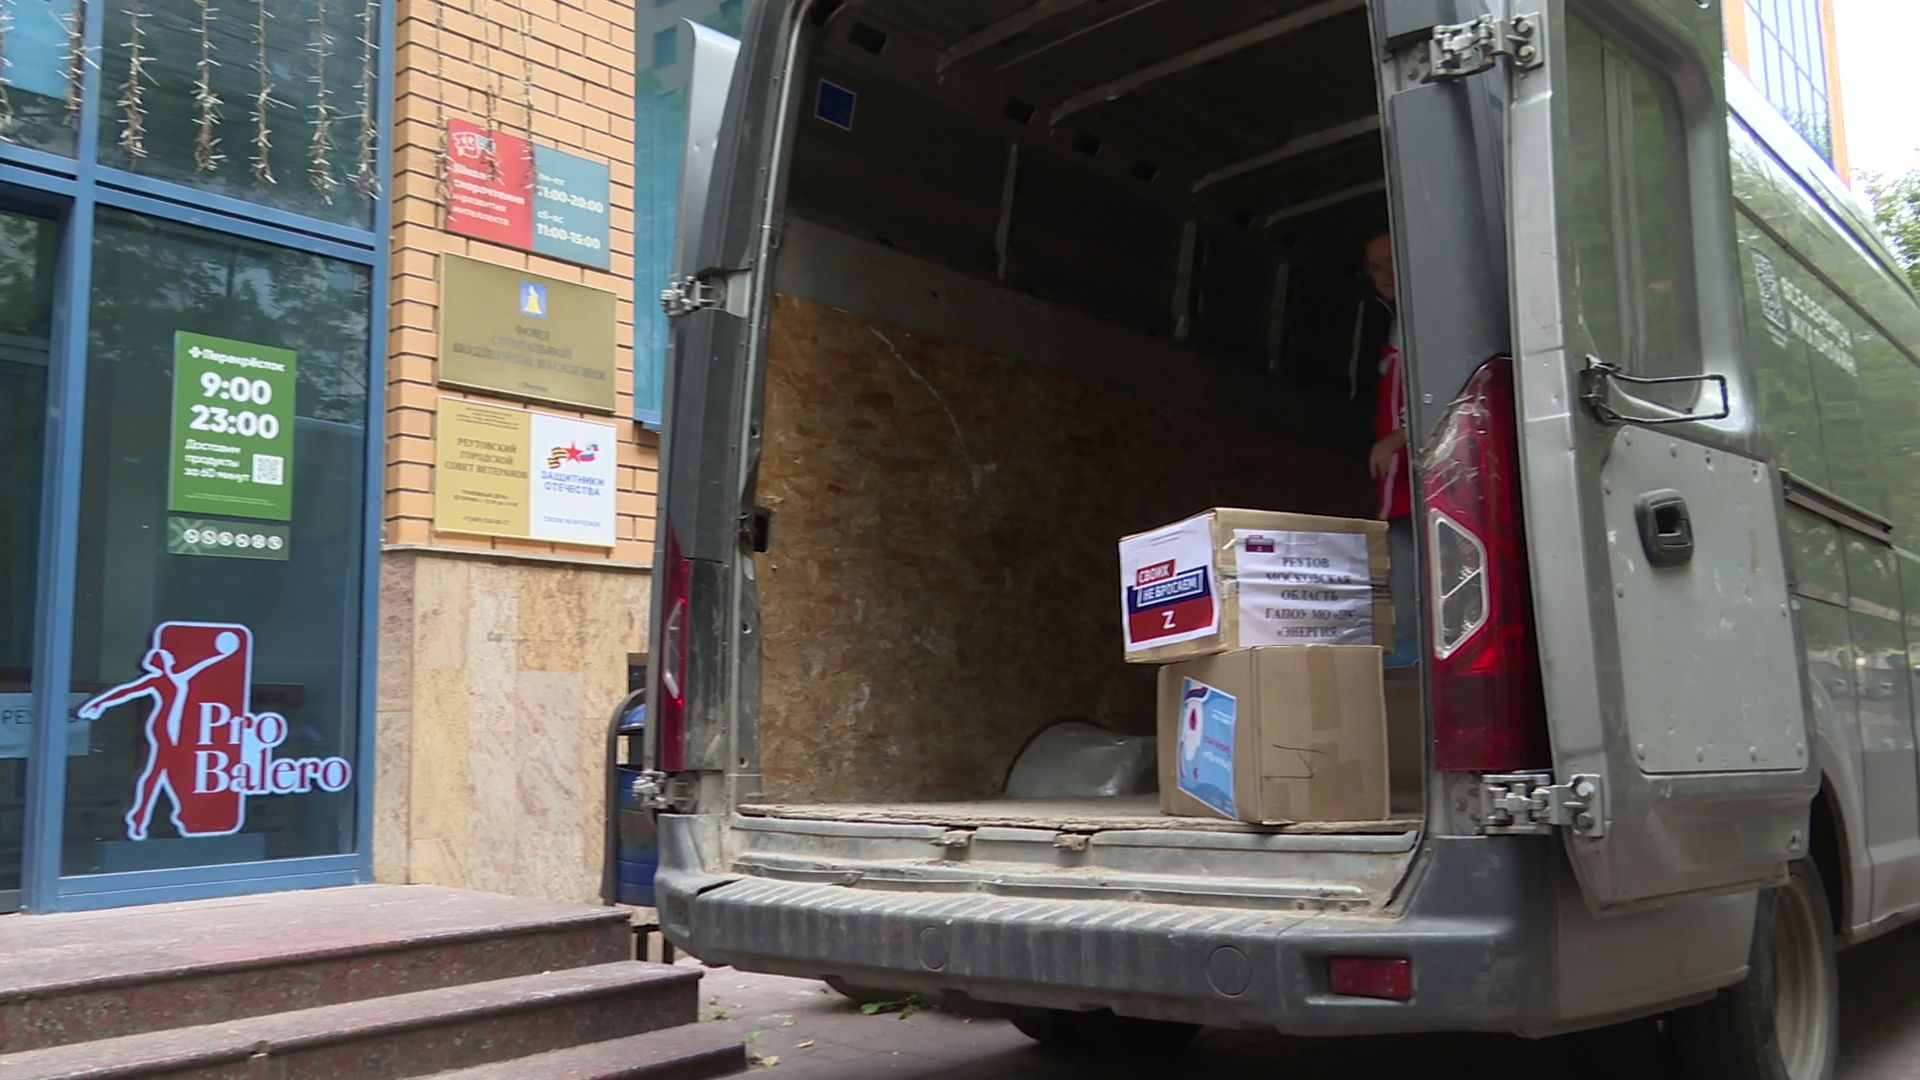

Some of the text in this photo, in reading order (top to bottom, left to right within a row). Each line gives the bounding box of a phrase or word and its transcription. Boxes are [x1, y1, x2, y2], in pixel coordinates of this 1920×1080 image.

[200, 371, 273, 405] 9:00
[189, 404, 280, 440] 23:00
[1282, 556, 1330, 569] РЕУТОВ
[1138, 564, 1171, 583] СВОИХ
[1266, 573, 1351, 585] МОСКОВСКАЯ
[1142, 588, 1155, 601] НЕ
[1281, 589, 1339, 601] ОБЛАСТЬ
[1161, 610, 1177, 629] Z
[1265, 607, 1307, 619] ГАПОУ
[1312, 609, 1332, 620] МО
[197, 701, 286, 746] Pro
[193, 747, 350, 794] Balero
